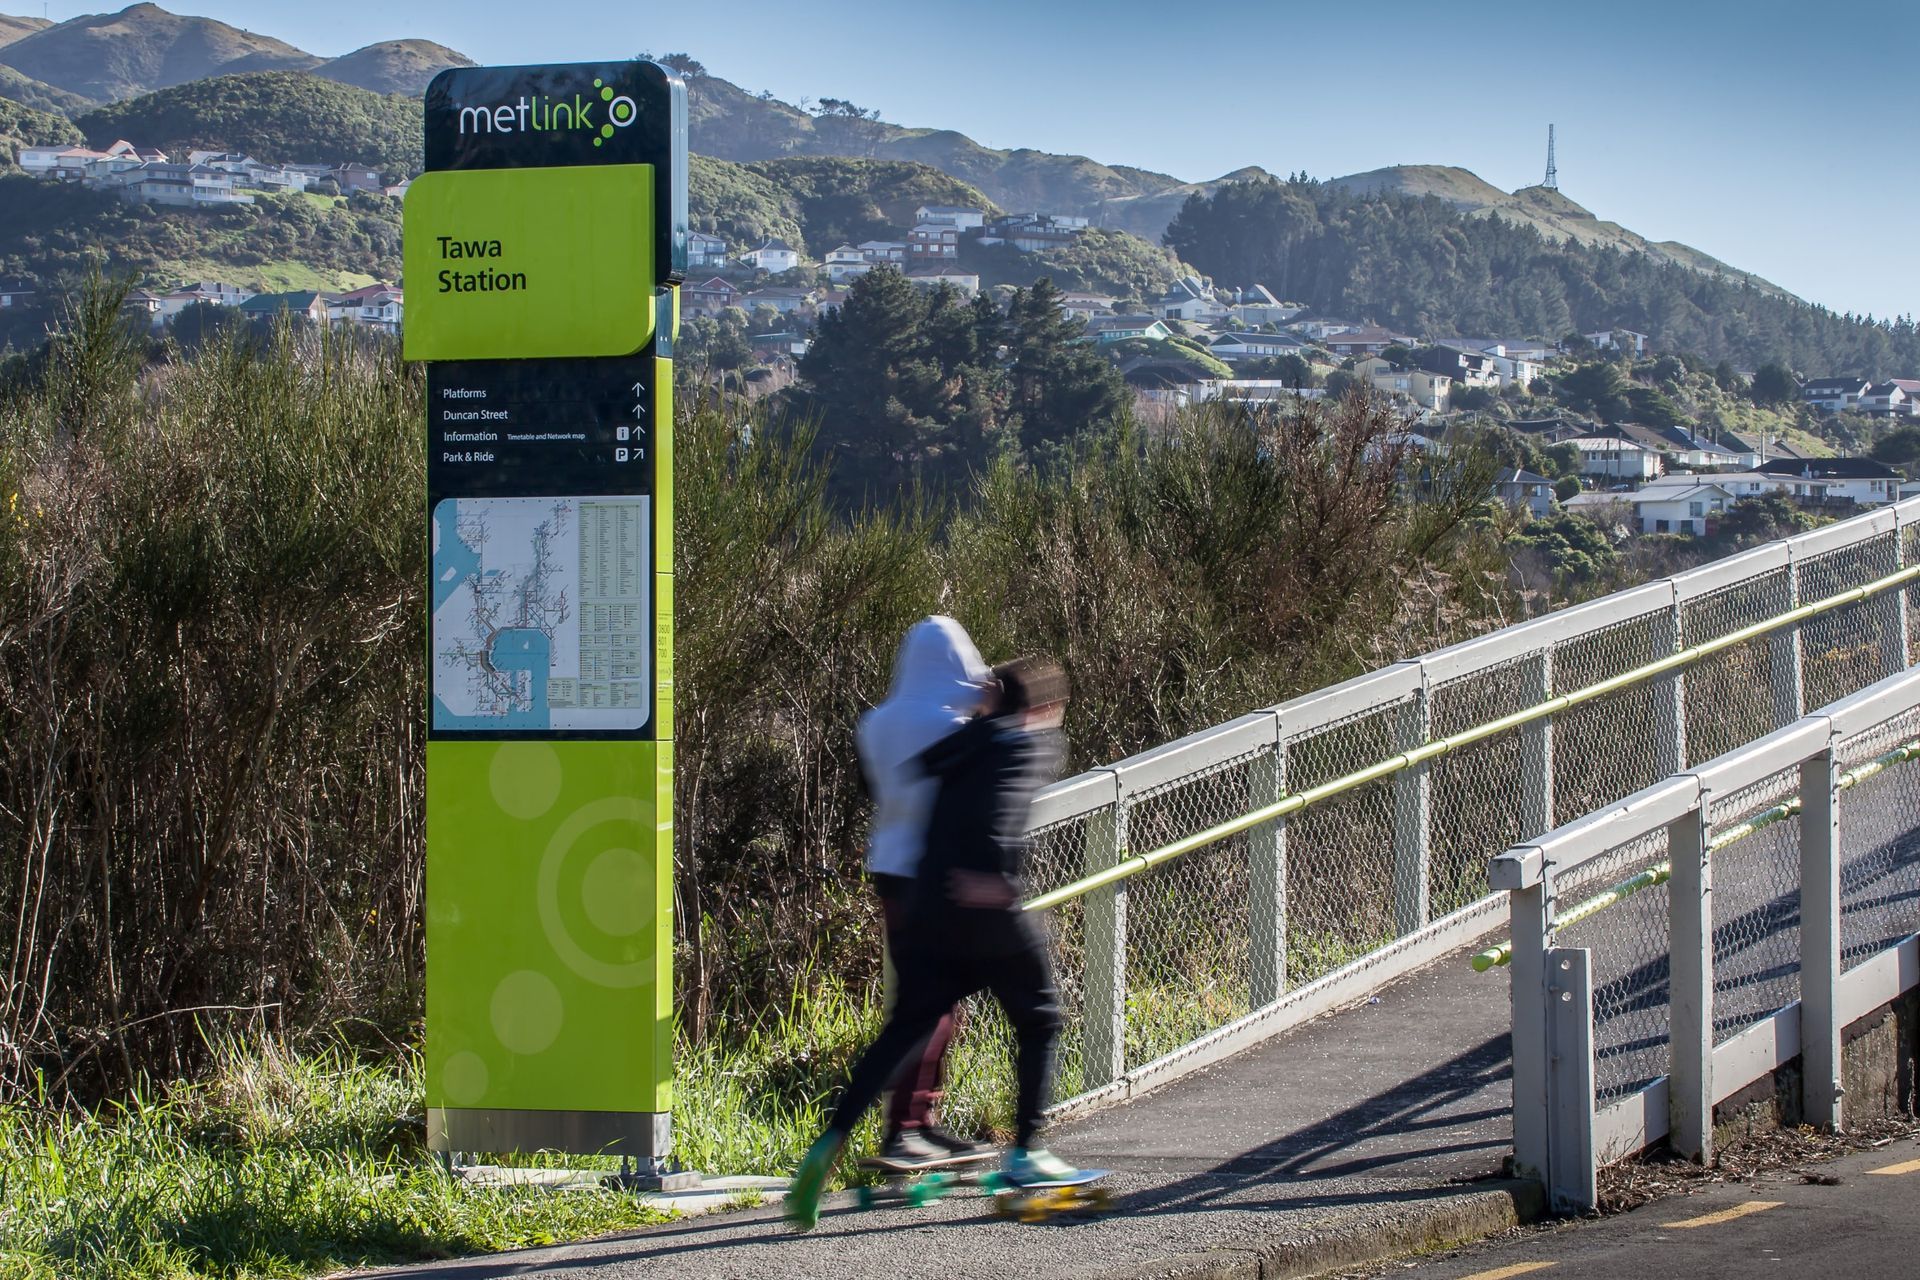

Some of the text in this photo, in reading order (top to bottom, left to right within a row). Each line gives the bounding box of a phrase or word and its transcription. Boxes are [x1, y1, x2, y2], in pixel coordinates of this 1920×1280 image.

[460, 94, 593, 134] metlink
[437, 236, 502, 259] Tawa
[438, 268, 527, 293] Station
[443, 388, 487, 398] Platforms
[443, 410, 508, 420] Duncan Street
[444, 431, 498, 441] Information
[443, 452, 495, 462] Park & Ride
[658, 624, 670, 634] 0800
